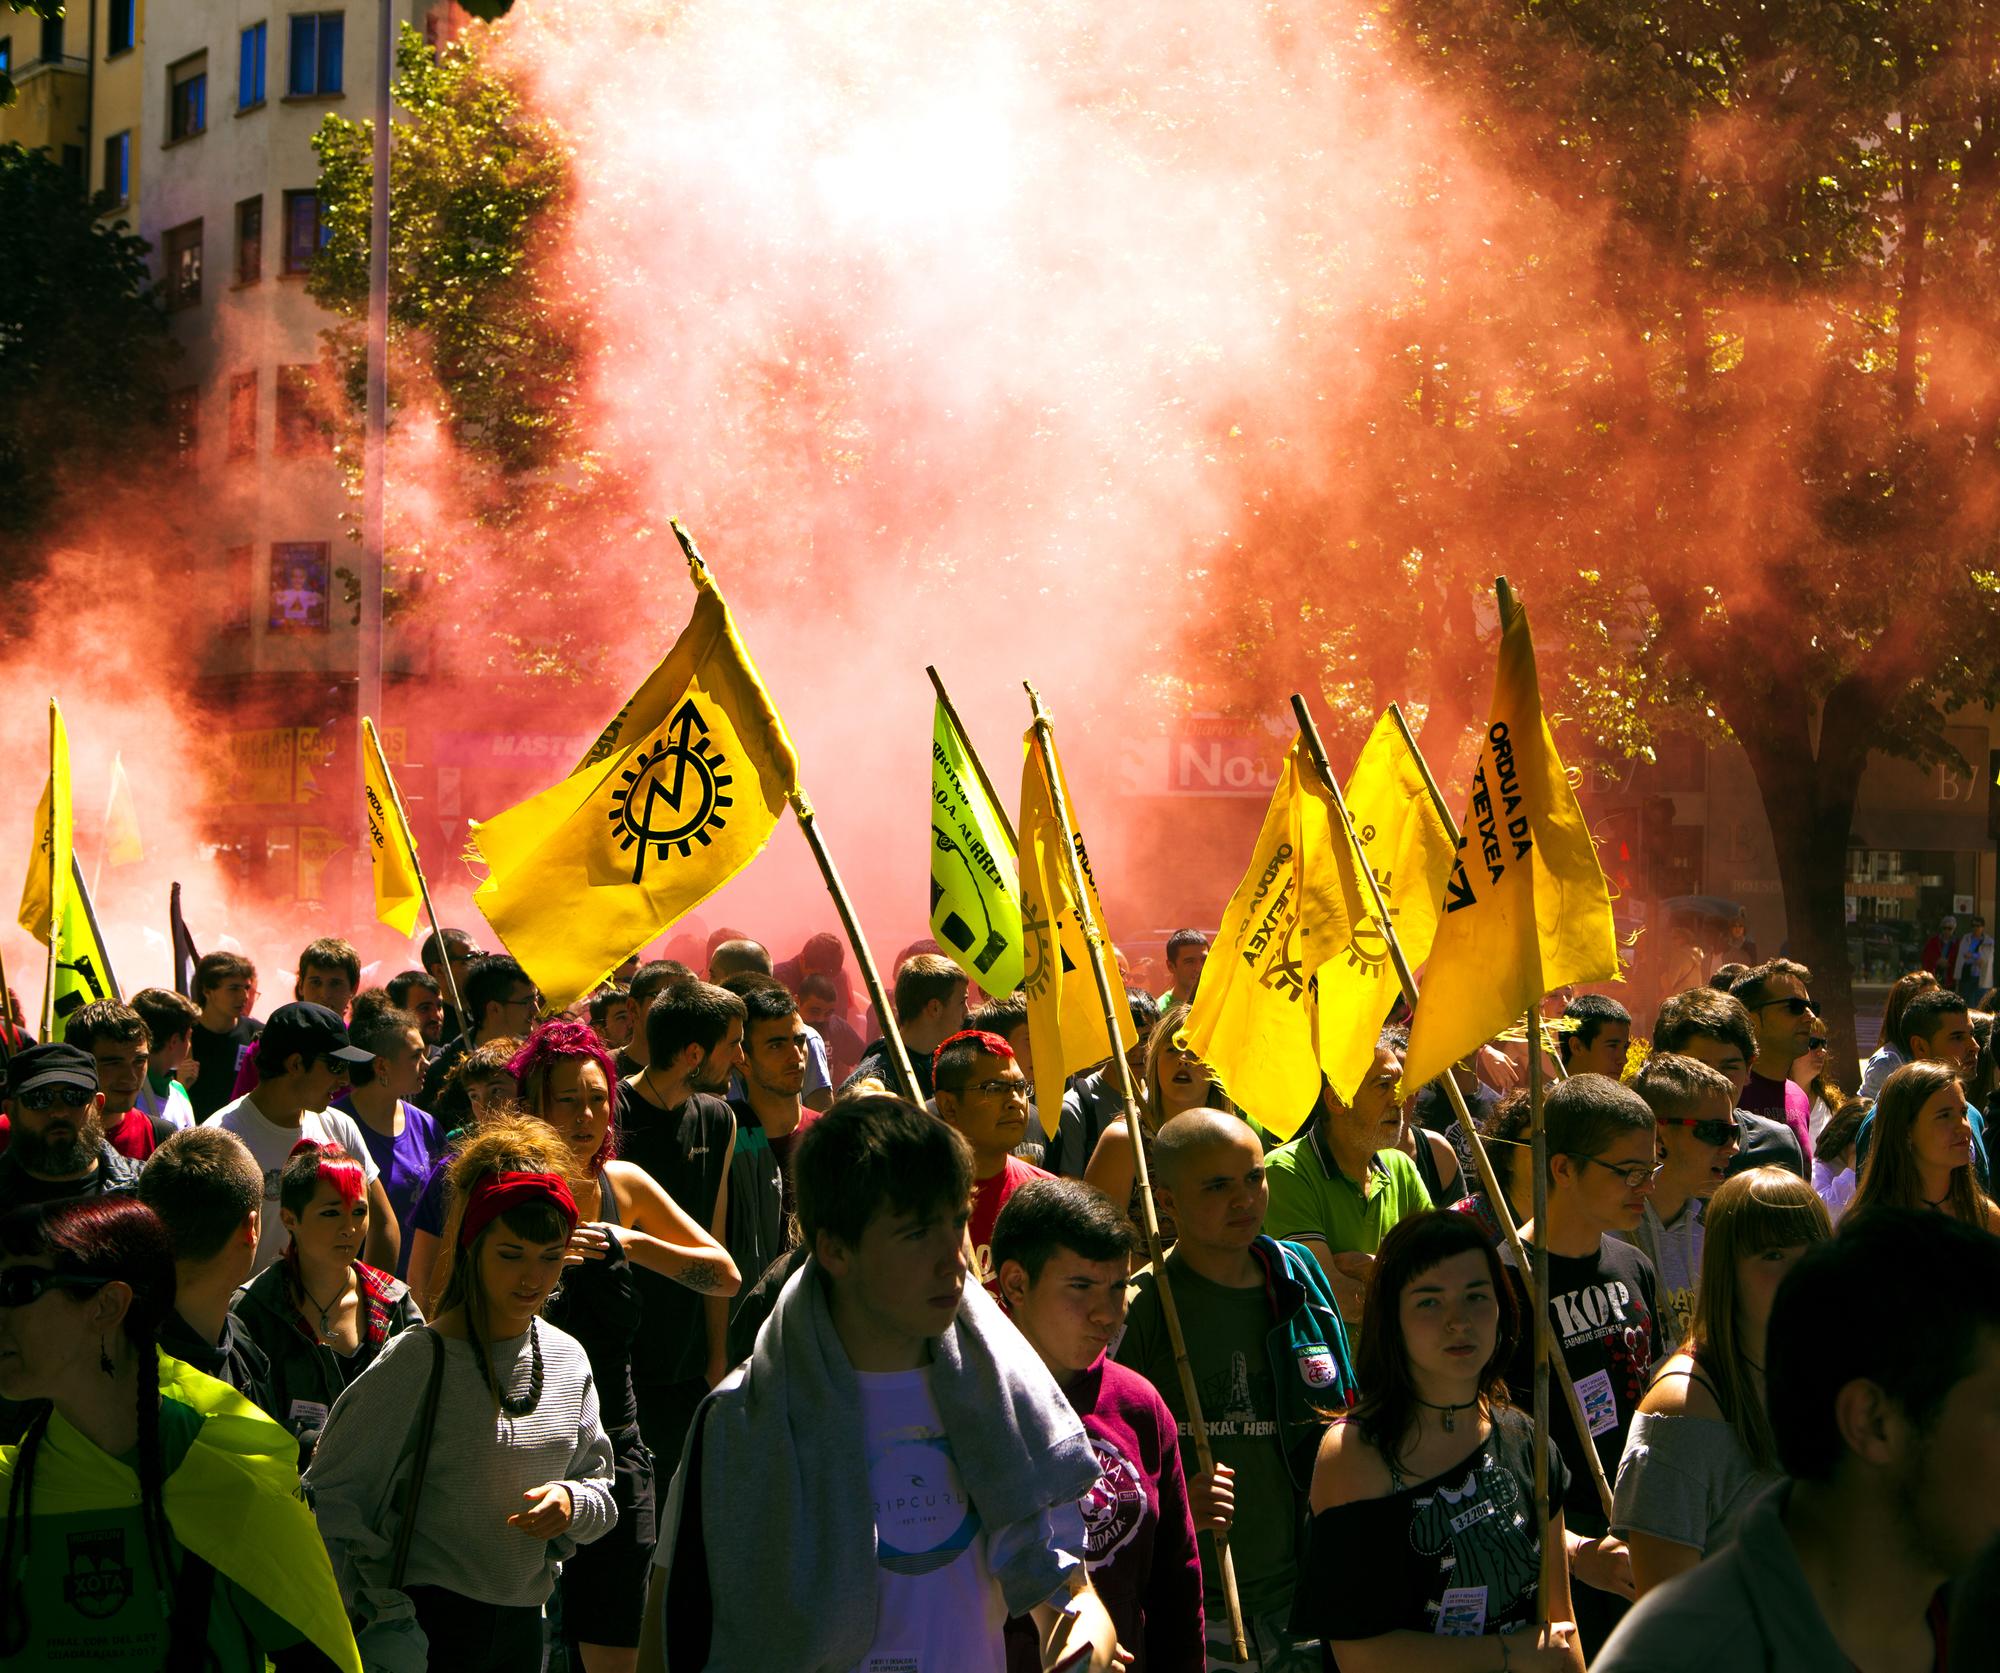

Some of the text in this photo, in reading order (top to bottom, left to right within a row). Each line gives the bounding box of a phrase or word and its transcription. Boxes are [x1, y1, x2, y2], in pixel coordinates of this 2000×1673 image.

[1473, 757, 1504, 886] ZTETXEA
[1489, 721, 1533, 861] ORDUA DA
[1549, 1281, 1630, 1338] KOP
[74, 1575, 125, 1595] XOTA
